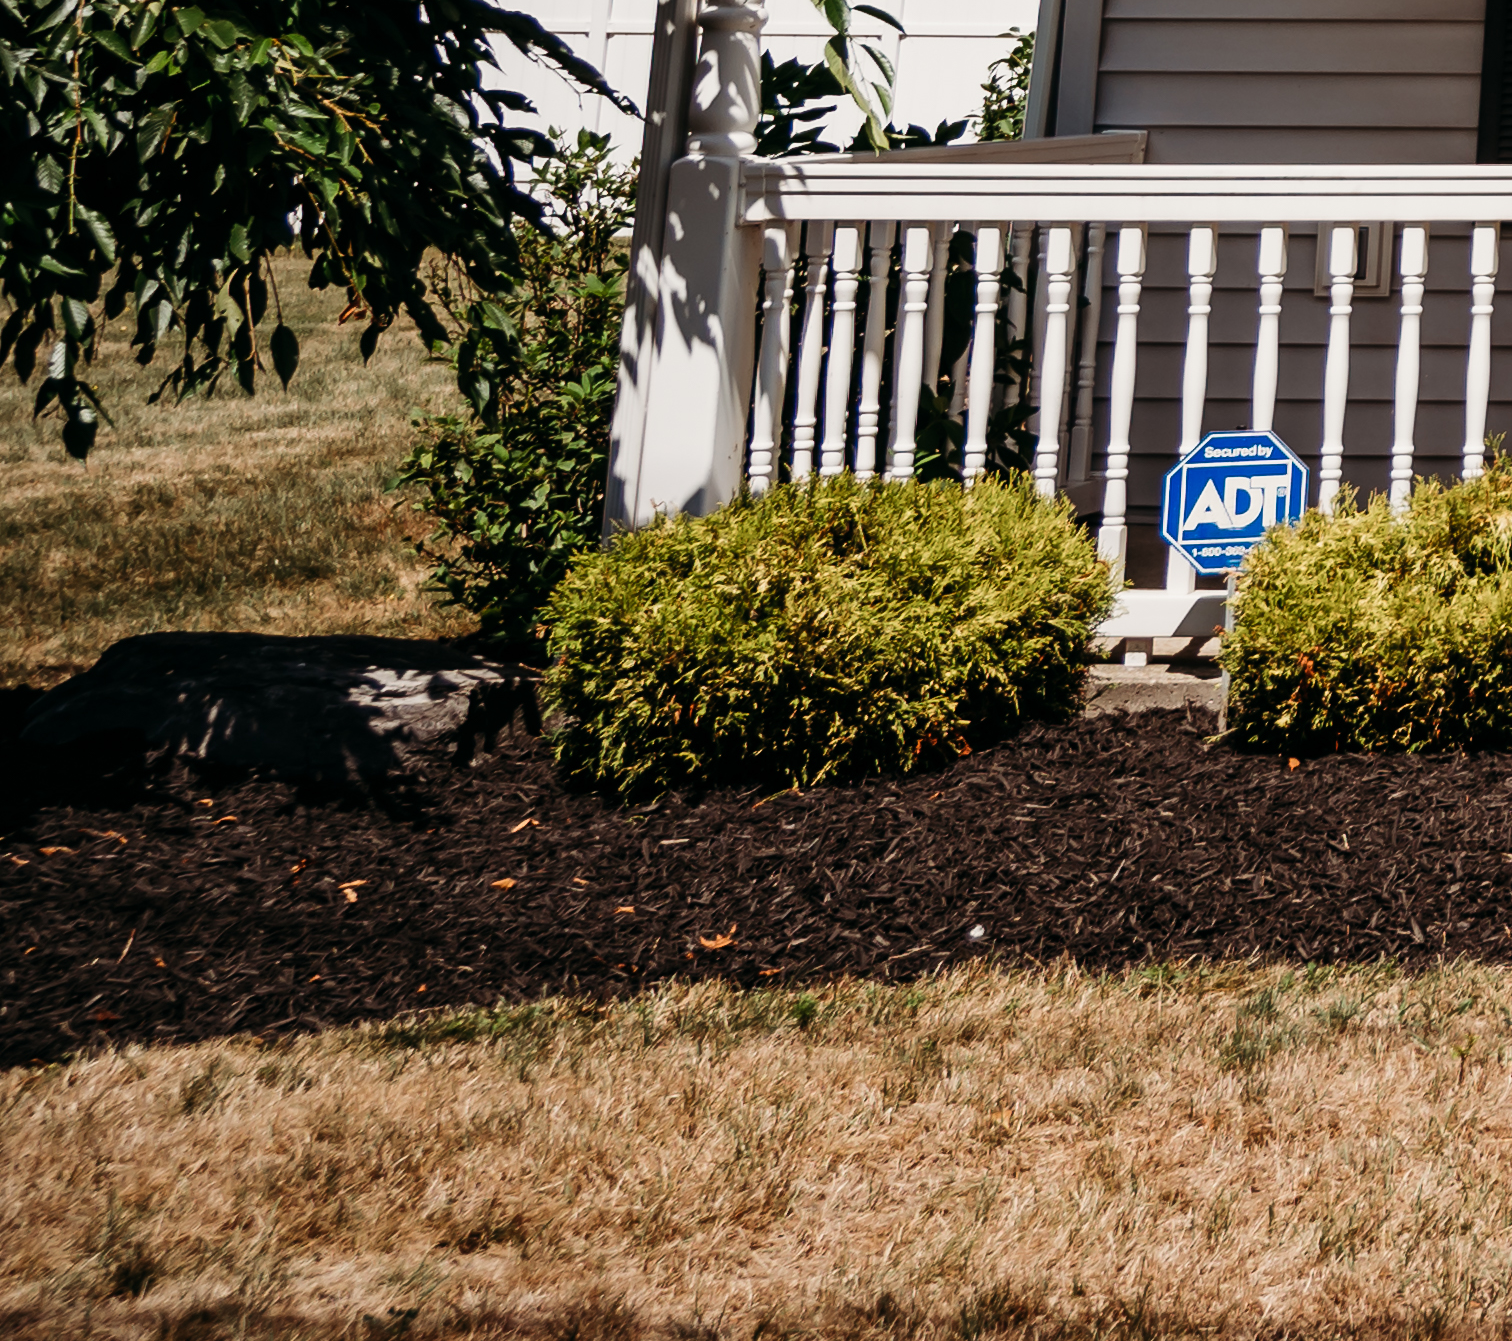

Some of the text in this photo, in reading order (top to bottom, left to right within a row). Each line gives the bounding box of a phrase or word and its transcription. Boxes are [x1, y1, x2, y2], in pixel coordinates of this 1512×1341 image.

[1204, 443, 1274, 459] Secured by
[1182, 474, 1289, 531] ADT
